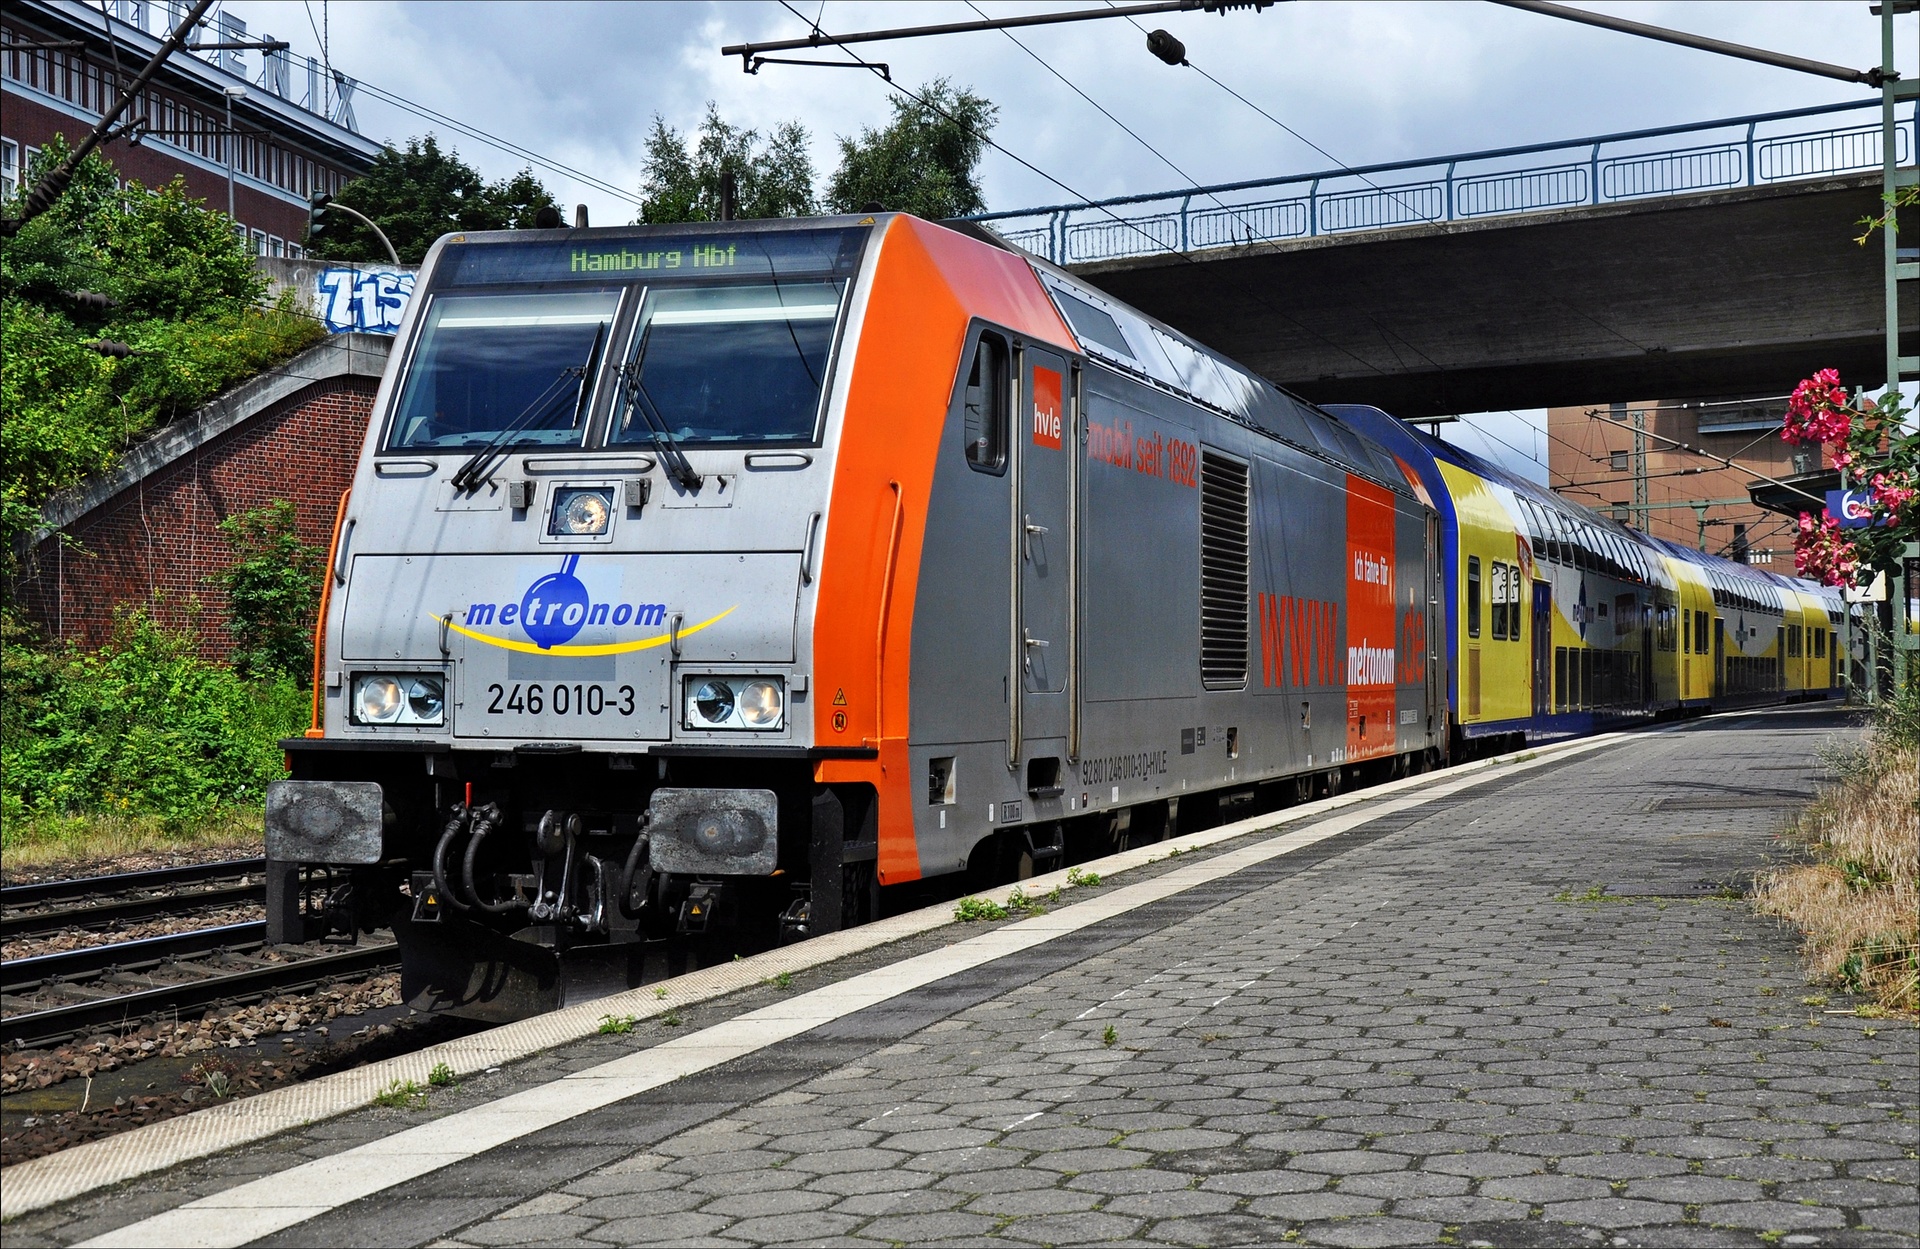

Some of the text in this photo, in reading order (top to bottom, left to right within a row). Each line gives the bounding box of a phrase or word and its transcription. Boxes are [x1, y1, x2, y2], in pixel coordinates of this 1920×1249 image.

[571, 243, 736, 272] Hamburg Hbf
[1033, 403, 1061, 440] hvle
[1088, 416, 1197, 489] mobil seit 1892
[1354, 551, 1389, 586] Ich fahre für
[466, 597, 667, 626] metronom
[487, 683, 636, 716] 246 010-3
